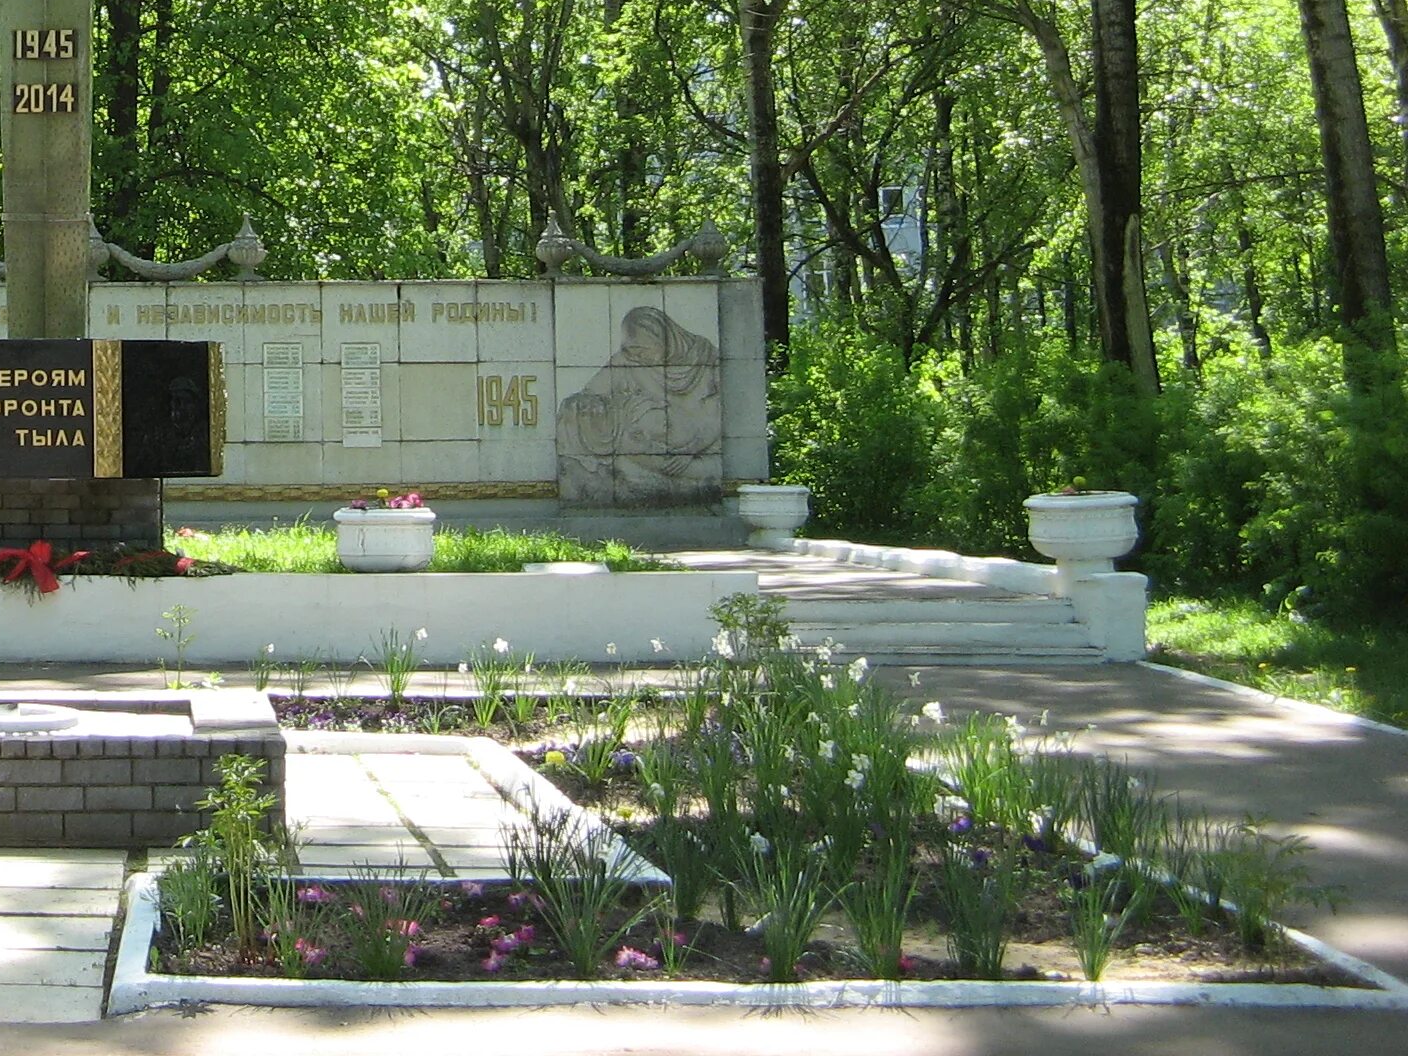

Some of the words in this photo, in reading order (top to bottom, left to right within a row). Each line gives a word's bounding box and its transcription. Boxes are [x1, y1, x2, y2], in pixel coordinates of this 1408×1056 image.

[15, 29, 74, 59] 1945
[15, 83, 75, 113] 2014
[106, 305, 121, 325] И
[136, 303, 324, 325] НЕЗАВИСИМОСТЬ
[339, 300, 416, 324] НАШЕЙ
[431, 301, 538, 324] РОДИНЫ!
[477, 375, 539, 427] 1945
[16, 428, 86, 447] ТЫЛА
